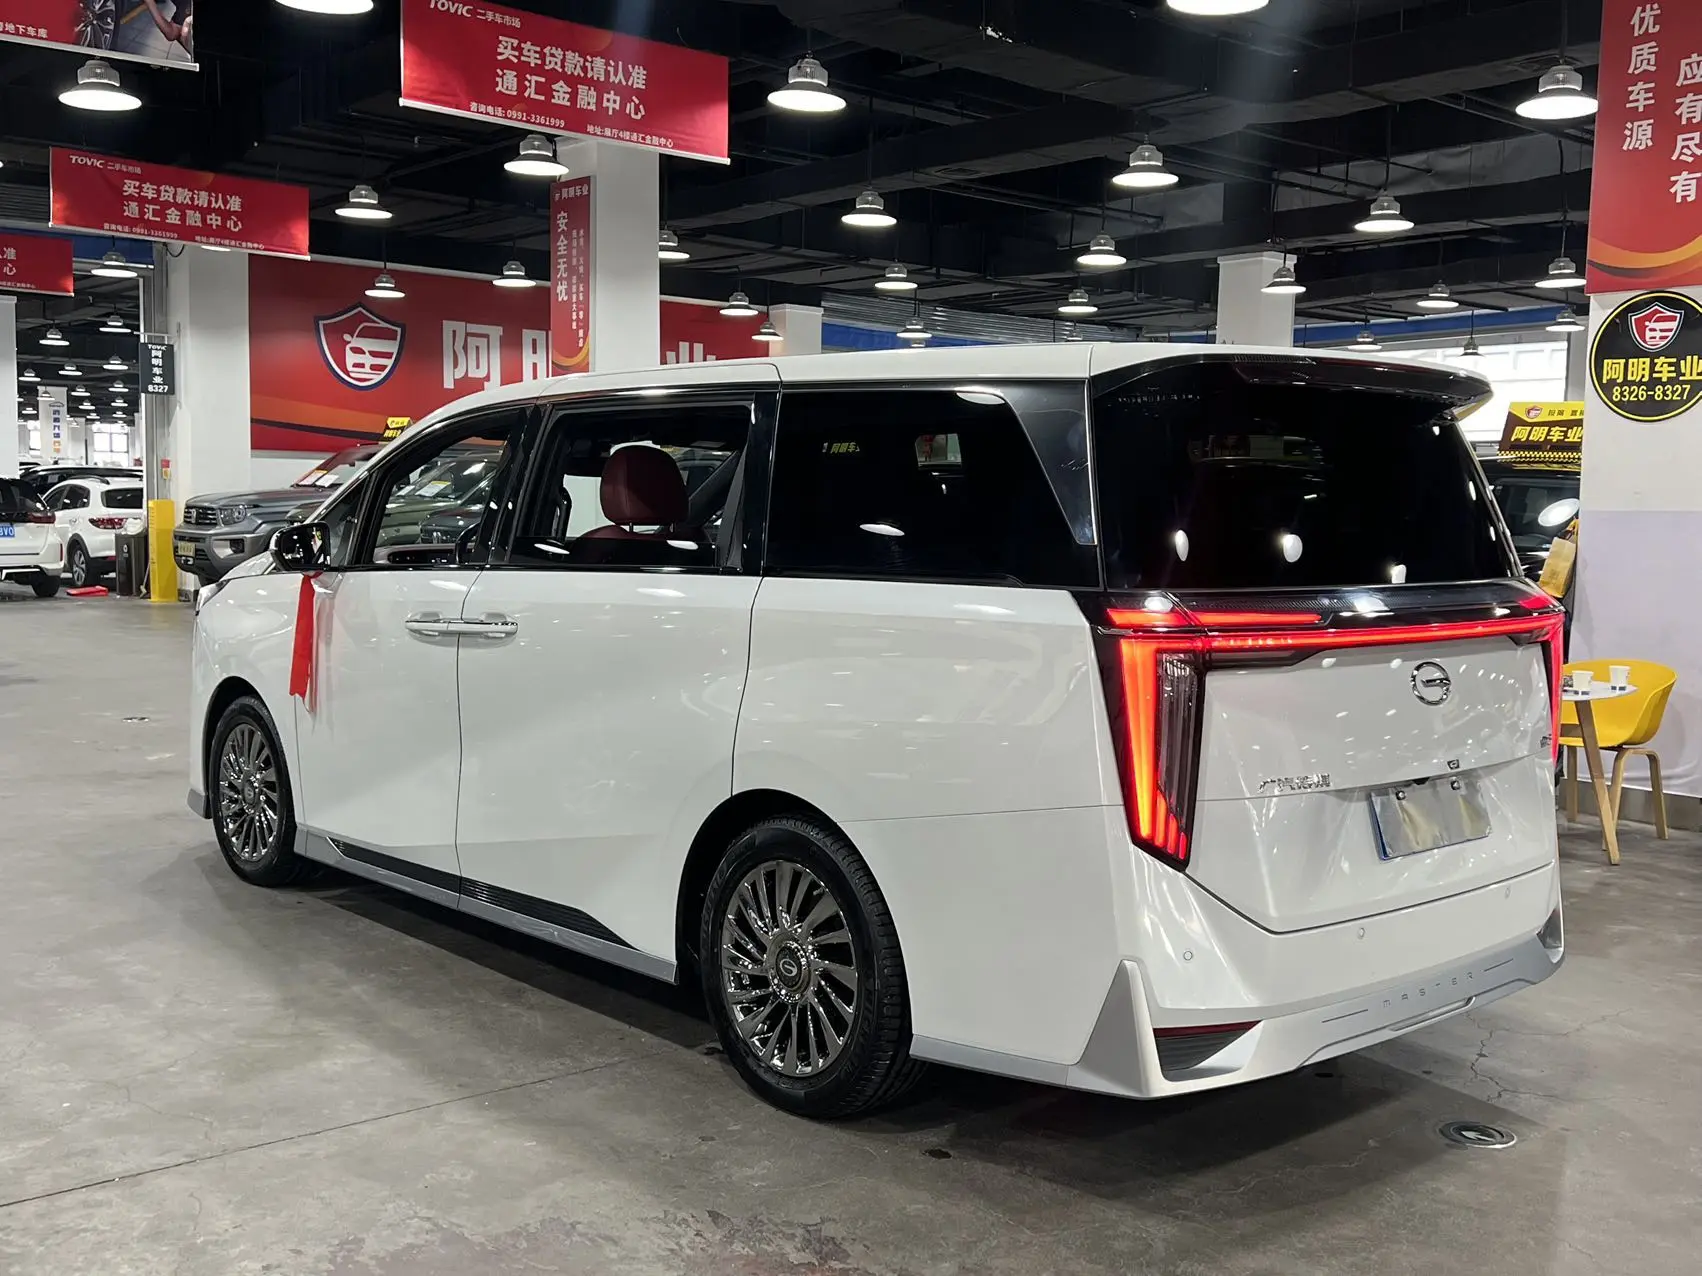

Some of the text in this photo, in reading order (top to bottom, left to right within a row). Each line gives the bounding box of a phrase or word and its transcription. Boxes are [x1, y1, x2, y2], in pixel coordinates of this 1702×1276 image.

[430, 0, 473, 17] TOVIC
[477, 9, 520, 28] 二手车市场
[496, 35, 647, 90] 买车贷款请认准
[1622, 3, 1661, 151] 优质车源
[496, 68, 646, 120] 通汇金融中心
[506, 109, 565, 128] 0991-3361999
[1669, 53, 1702, 204] 应有尽有
[69, 155, 104, 168] TOVIC
[122, 179, 242, 212] 买车贷款请认准
[122, 201, 242, 232] 通汇金融中心
[0, 247, 16, 260] 准
[556, 211, 569, 302] 安全无忧
[1602, 355, 1702, 384] 阿明车业
[148, 384, 168, 392] 8327
[1612, 384, 1691, 402] 8326-8327
[1511, 425, 1584, 442] 阿明车业
